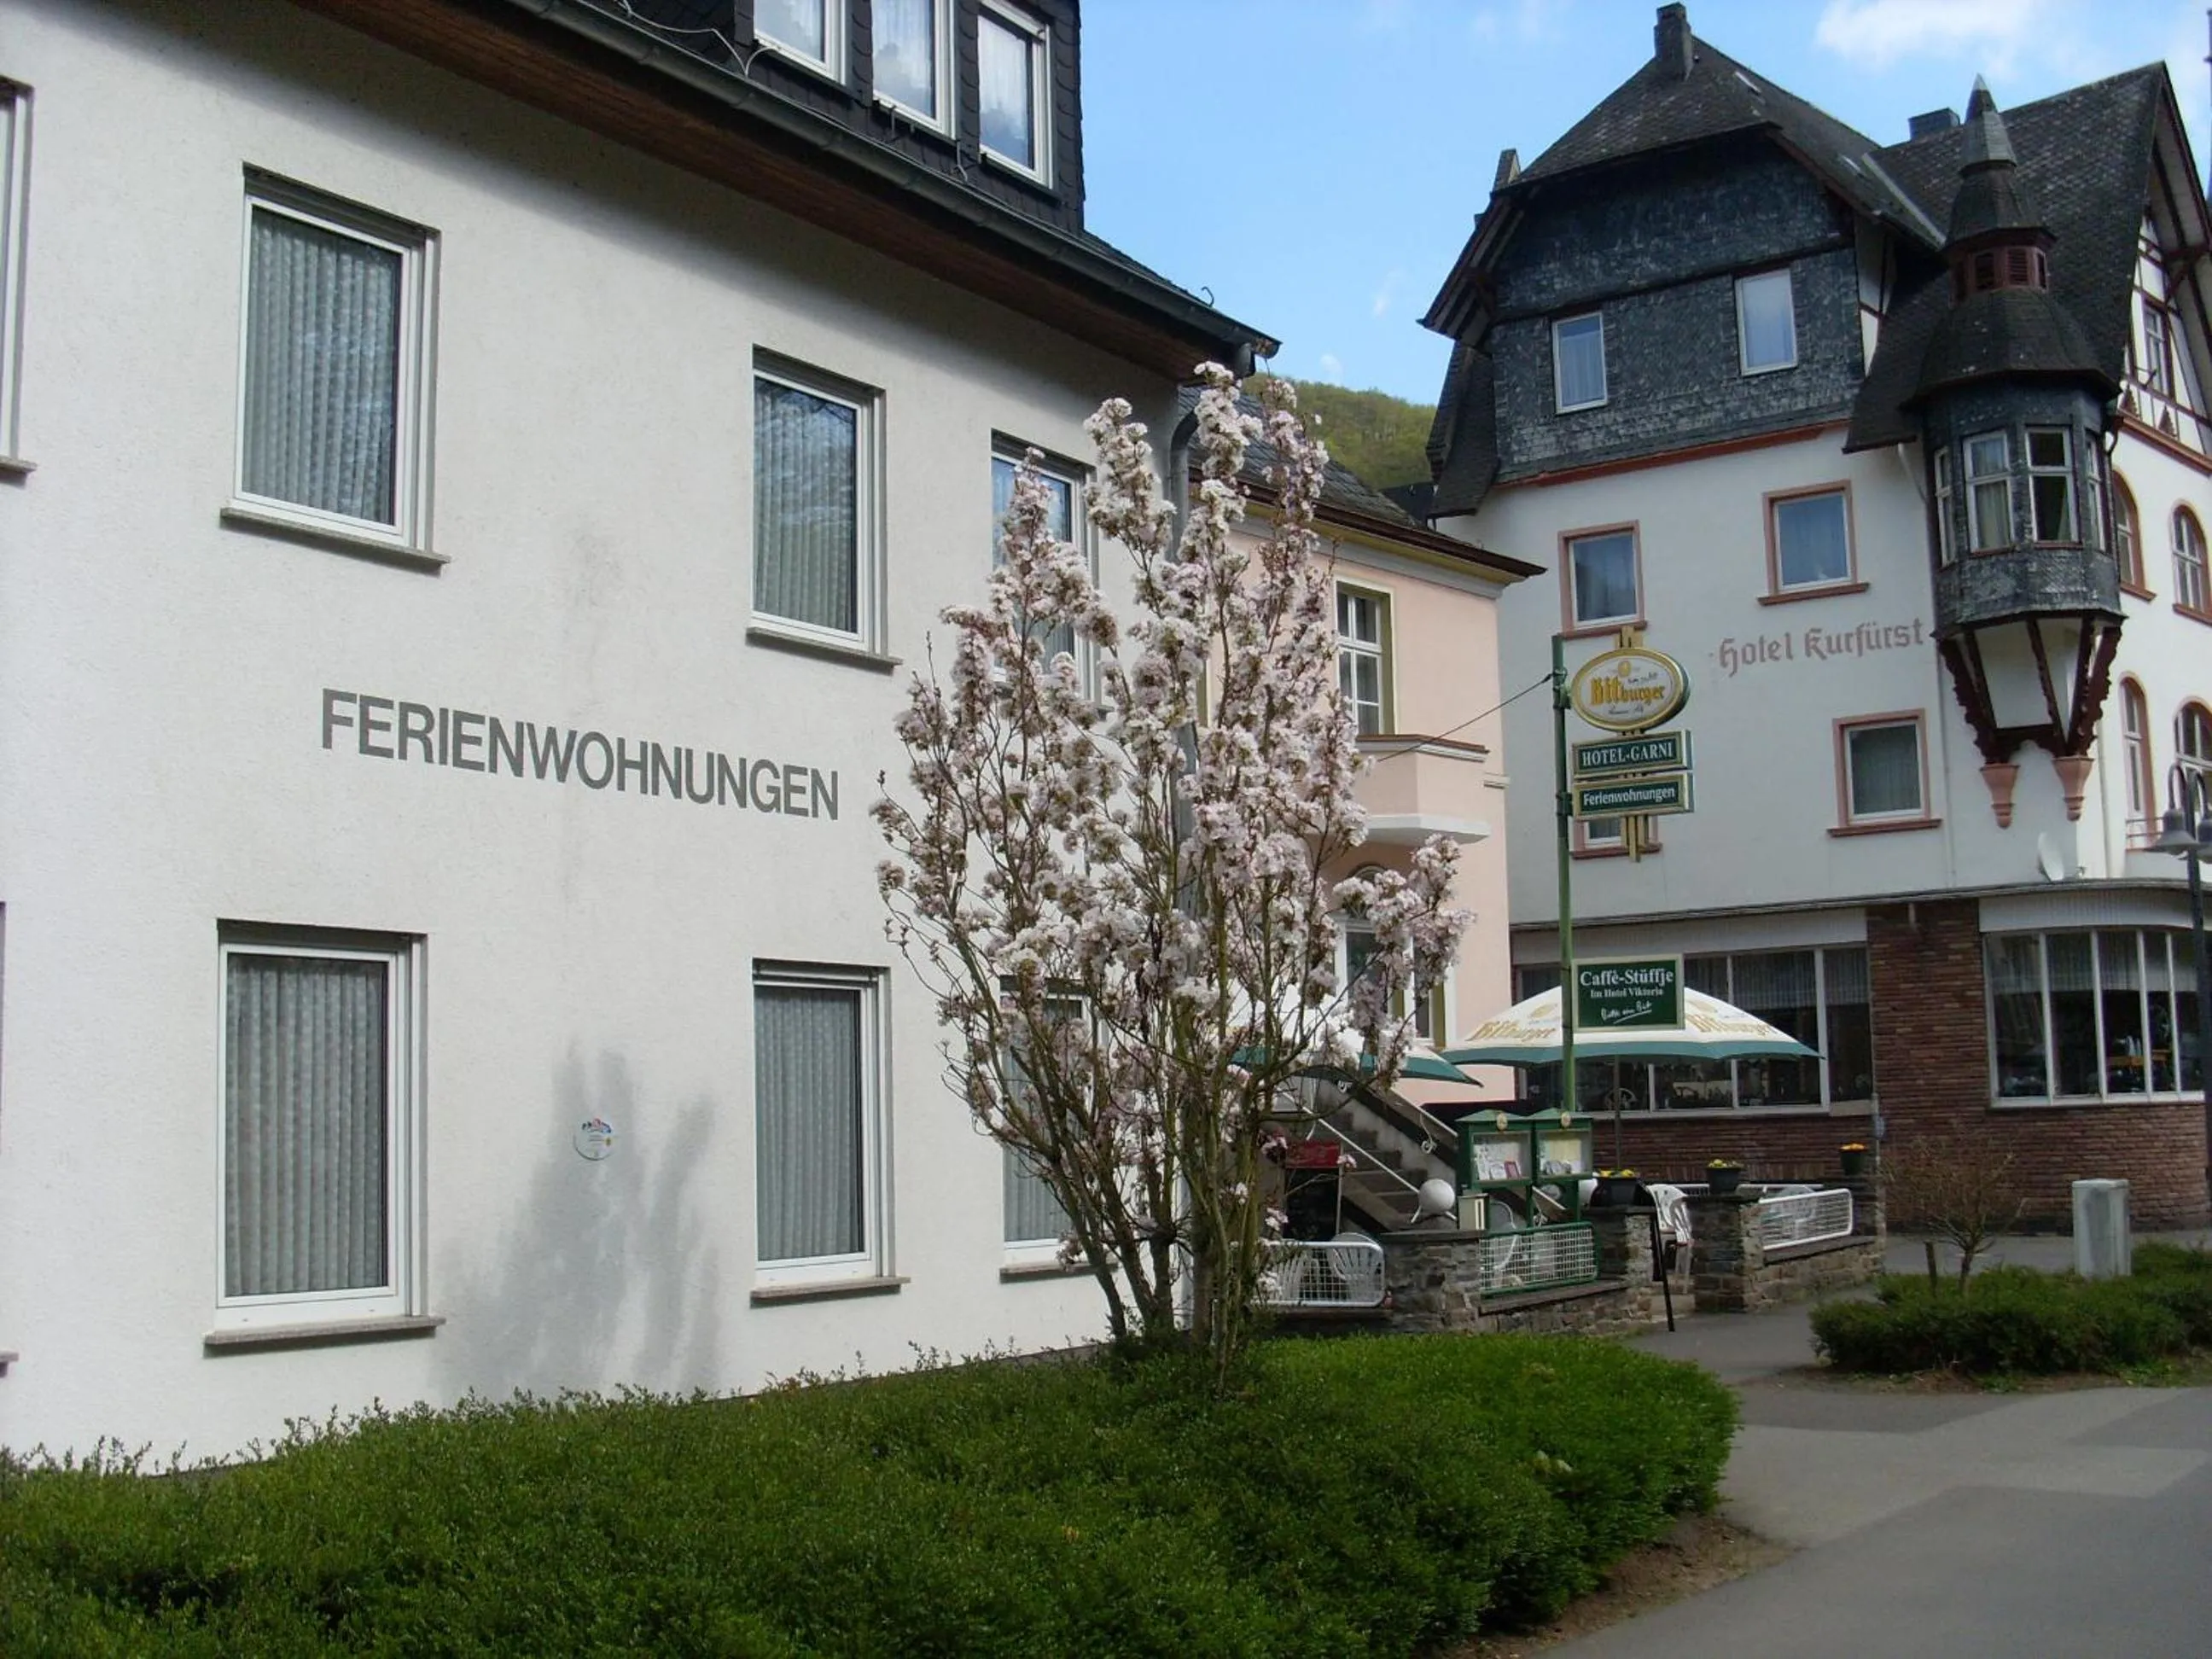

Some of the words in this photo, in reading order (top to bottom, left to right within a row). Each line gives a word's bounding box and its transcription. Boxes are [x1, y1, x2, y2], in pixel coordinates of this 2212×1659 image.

[1719, 632, 1794, 678] Hotel
[1803, 618, 1924, 661] Kurfürst
[1590, 676, 1665, 706] Bitburger
[322, 688, 839, 821] FERIENWOHNUNGEN
[1582, 742, 1673, 766] HOTEL-GARNI
[1583, 787, 1674, 806] Ferienwohnungen
